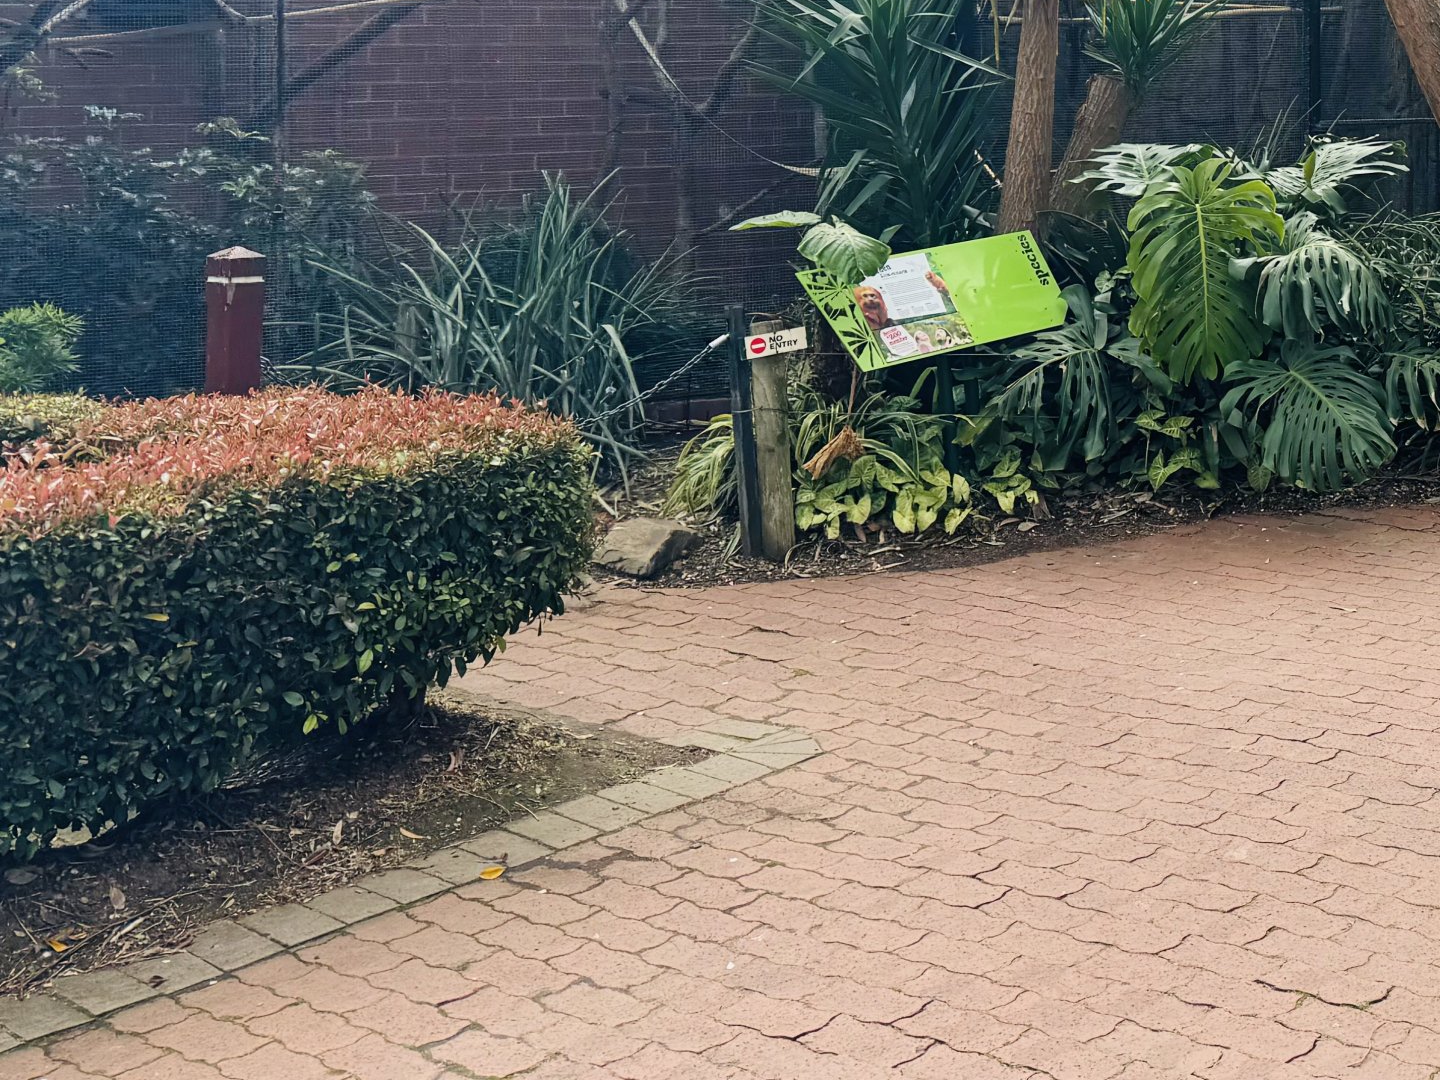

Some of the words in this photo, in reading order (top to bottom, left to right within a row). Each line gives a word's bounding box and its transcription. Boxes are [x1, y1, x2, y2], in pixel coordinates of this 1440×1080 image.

[1018, 234, 1050, 285] species
[769, 335, 783, 343] NO
[770, 339, 798, 350] ENTRY
